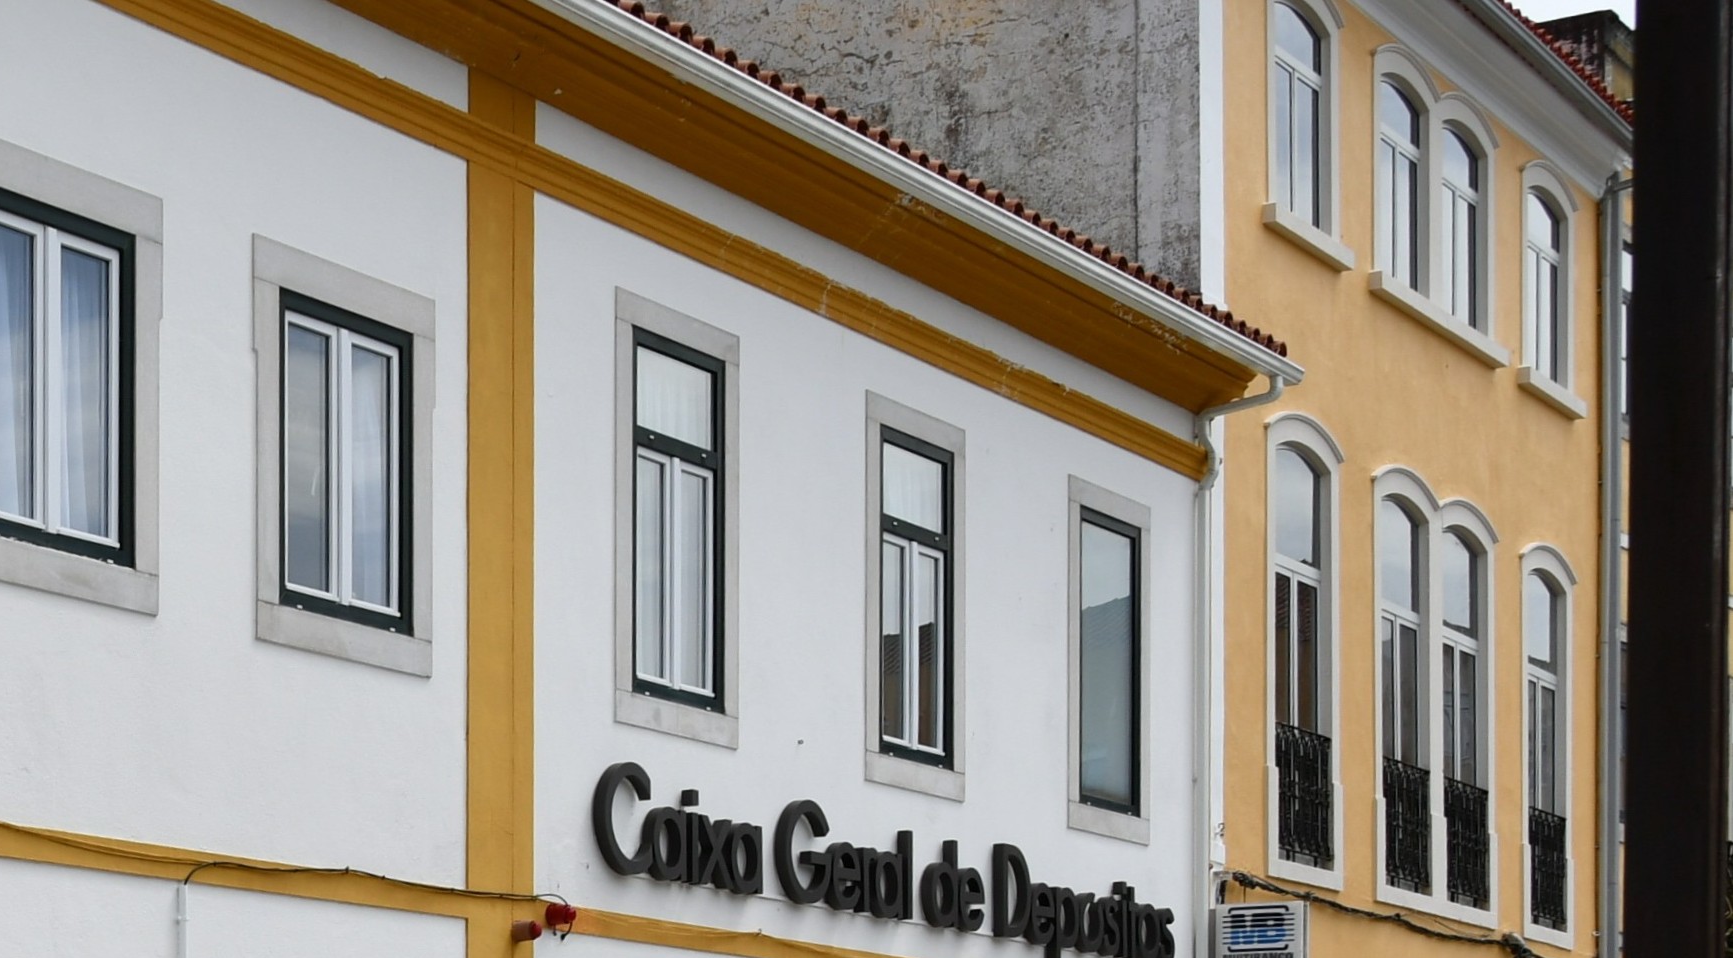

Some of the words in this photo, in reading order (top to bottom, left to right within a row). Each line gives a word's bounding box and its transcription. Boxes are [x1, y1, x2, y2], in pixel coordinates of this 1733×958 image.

[593, 762, 763, 894] Caixa
[774, 799, 913, 921] Geral
[920, 840, 985, 932] de
[1229, 912, 1286, 945] MB
